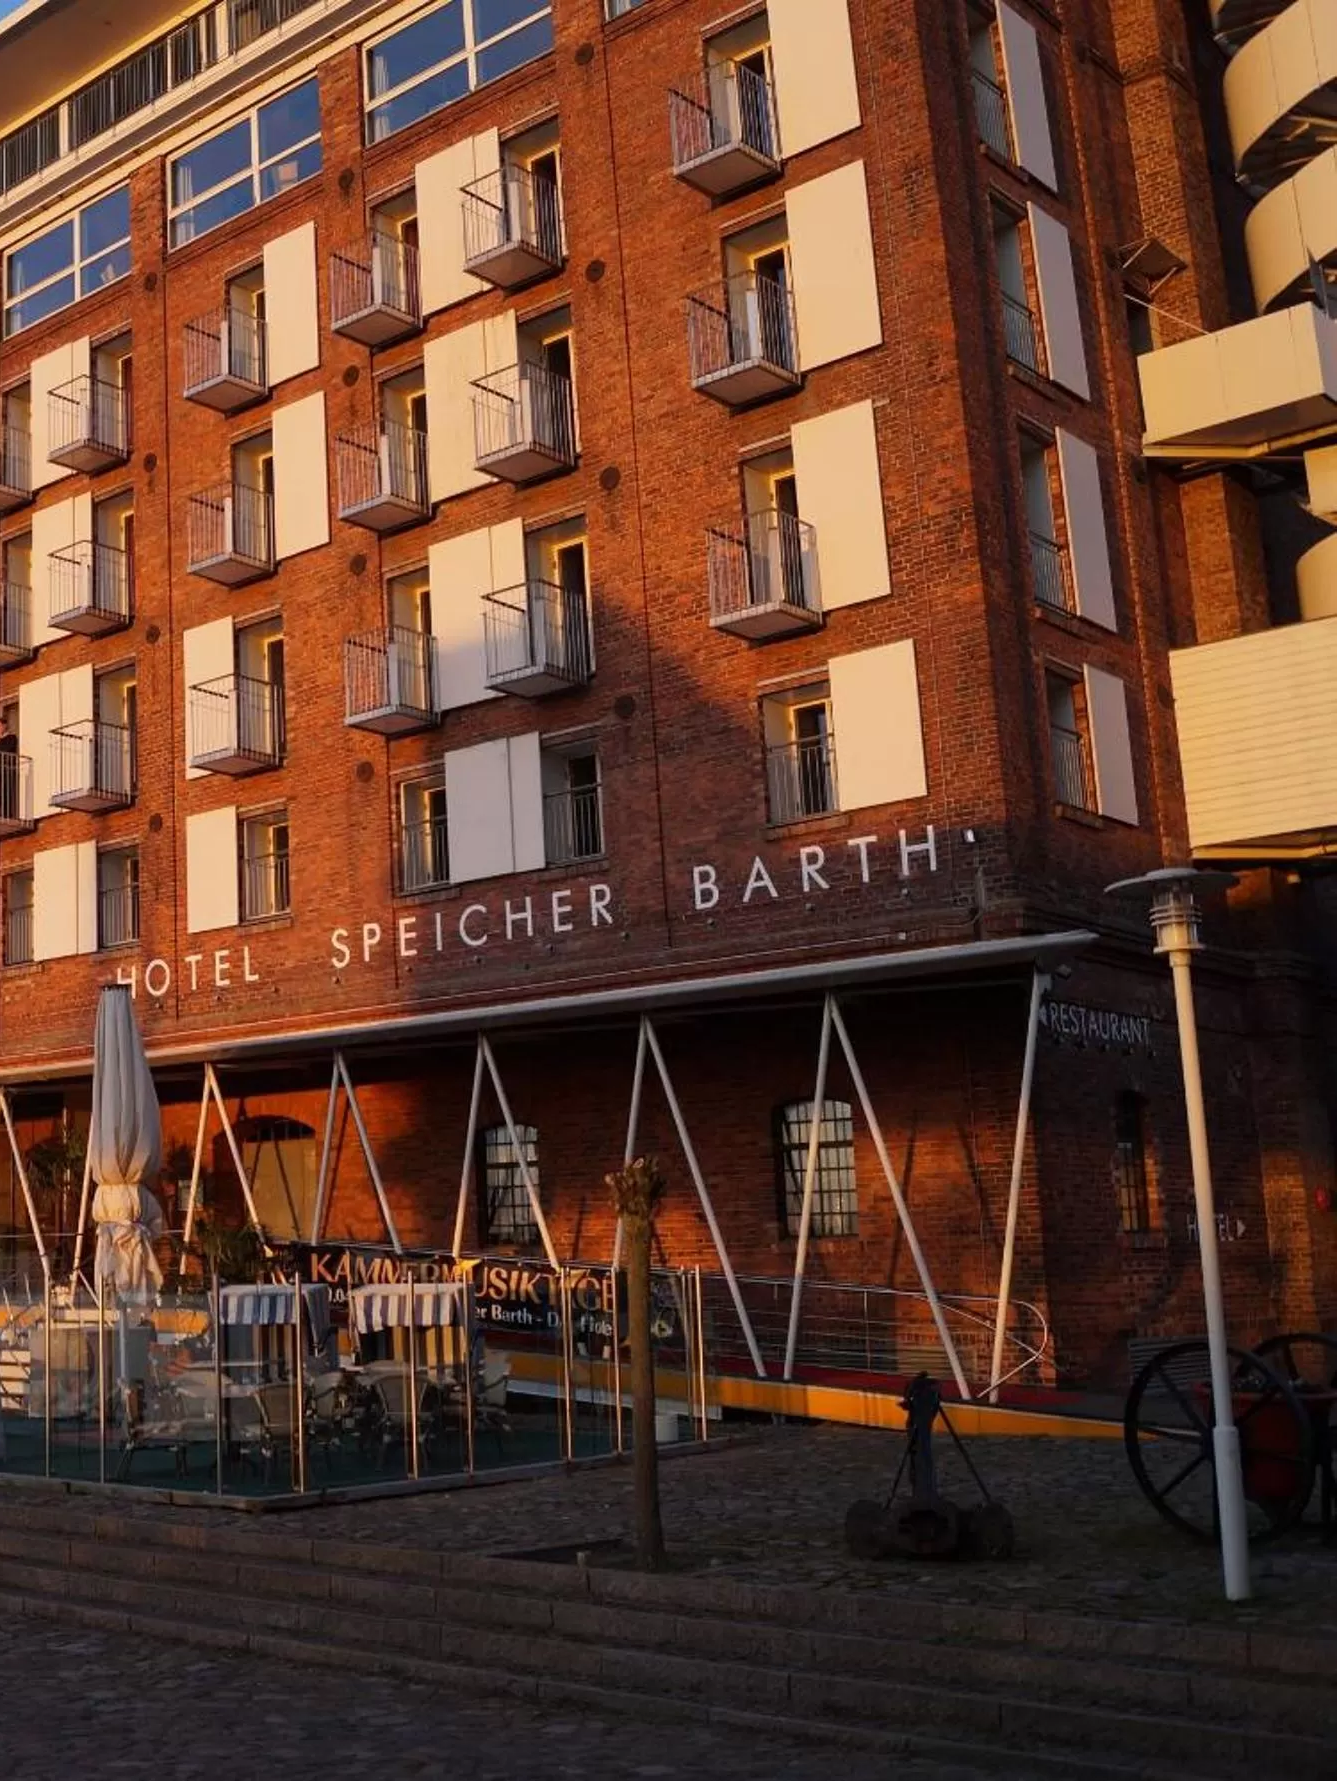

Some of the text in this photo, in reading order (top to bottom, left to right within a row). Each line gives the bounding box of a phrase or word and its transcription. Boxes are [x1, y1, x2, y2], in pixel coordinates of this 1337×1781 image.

[116, 823, 940, 1000] HOTEL SPEICHER BARTH
[1049, 1001, 1150, 1045] RESTAURANT
[1185, 1212, 1235, 1243] HEL
[490, 1303, 533, 1325] Barth
[580, 1314, 616, 1337] Hote
